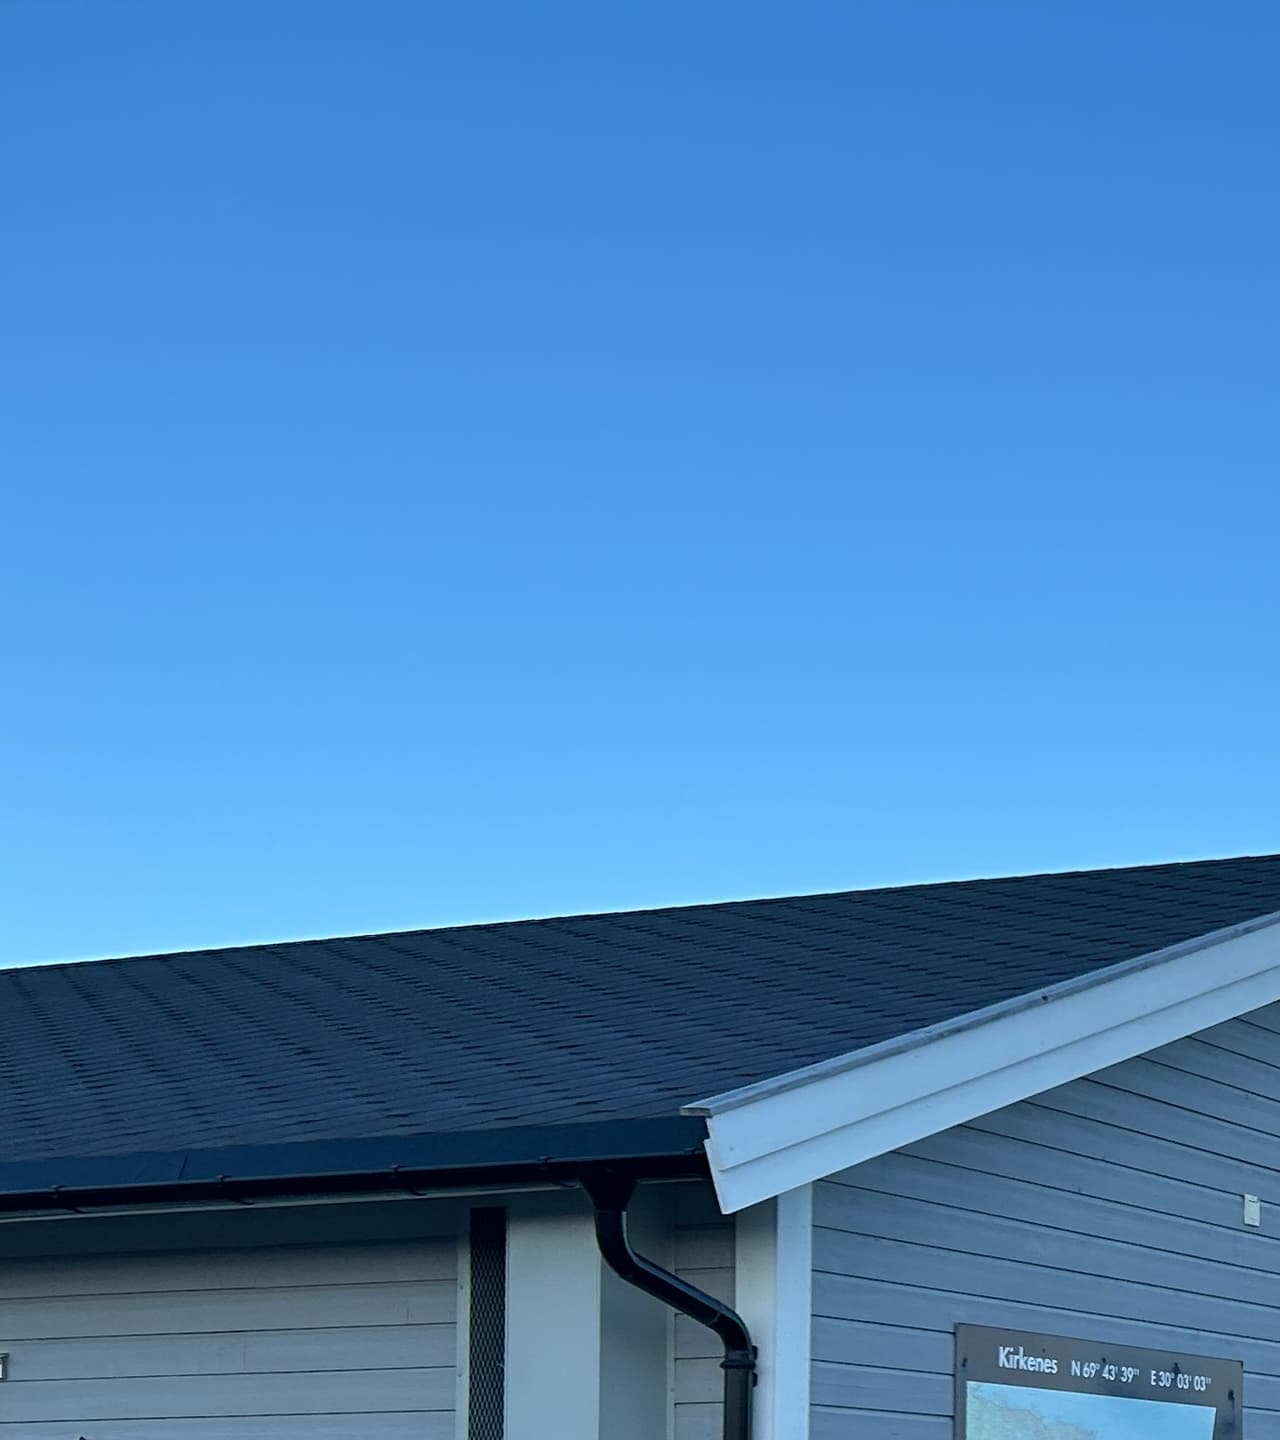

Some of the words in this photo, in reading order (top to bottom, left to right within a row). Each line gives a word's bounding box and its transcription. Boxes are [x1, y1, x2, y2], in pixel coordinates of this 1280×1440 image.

[998, 1346, 1058, 1374] Kirkenes
[1071, 1360, 1081, 1376] N
[1150, 1370, 1157, 1386] E
